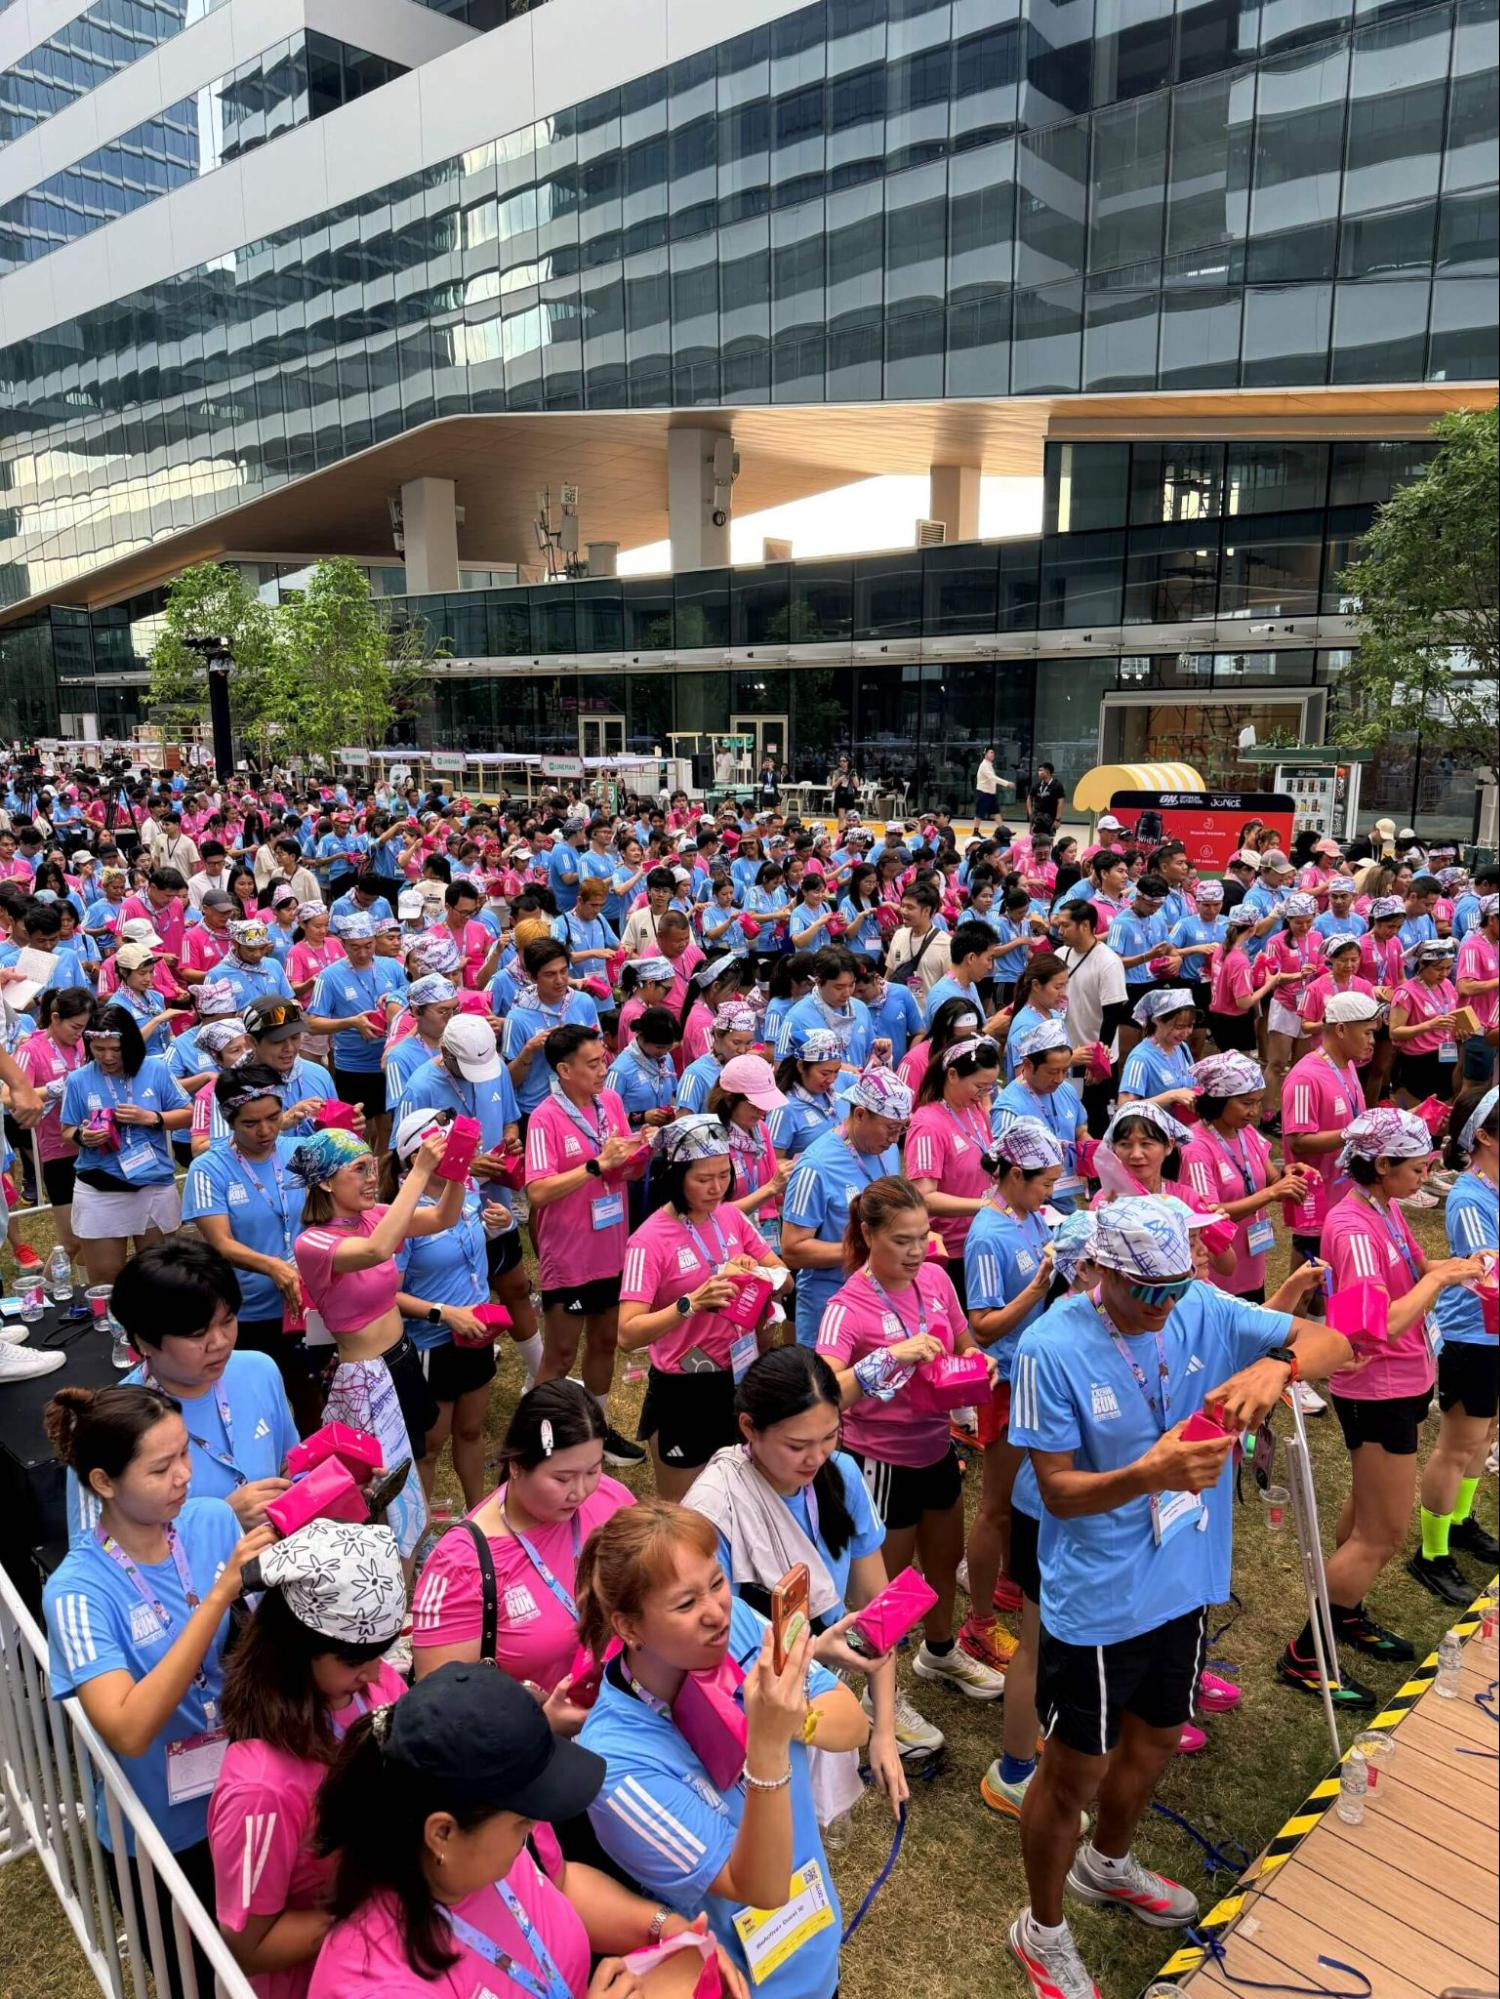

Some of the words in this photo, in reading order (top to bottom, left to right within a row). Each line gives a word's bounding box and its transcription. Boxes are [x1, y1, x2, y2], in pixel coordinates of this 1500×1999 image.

[1092, 1394, 1119, 1415] RUN
[505, 1594, 537, 1619] RUN
[132, 1612, 161, 1642] RUN
